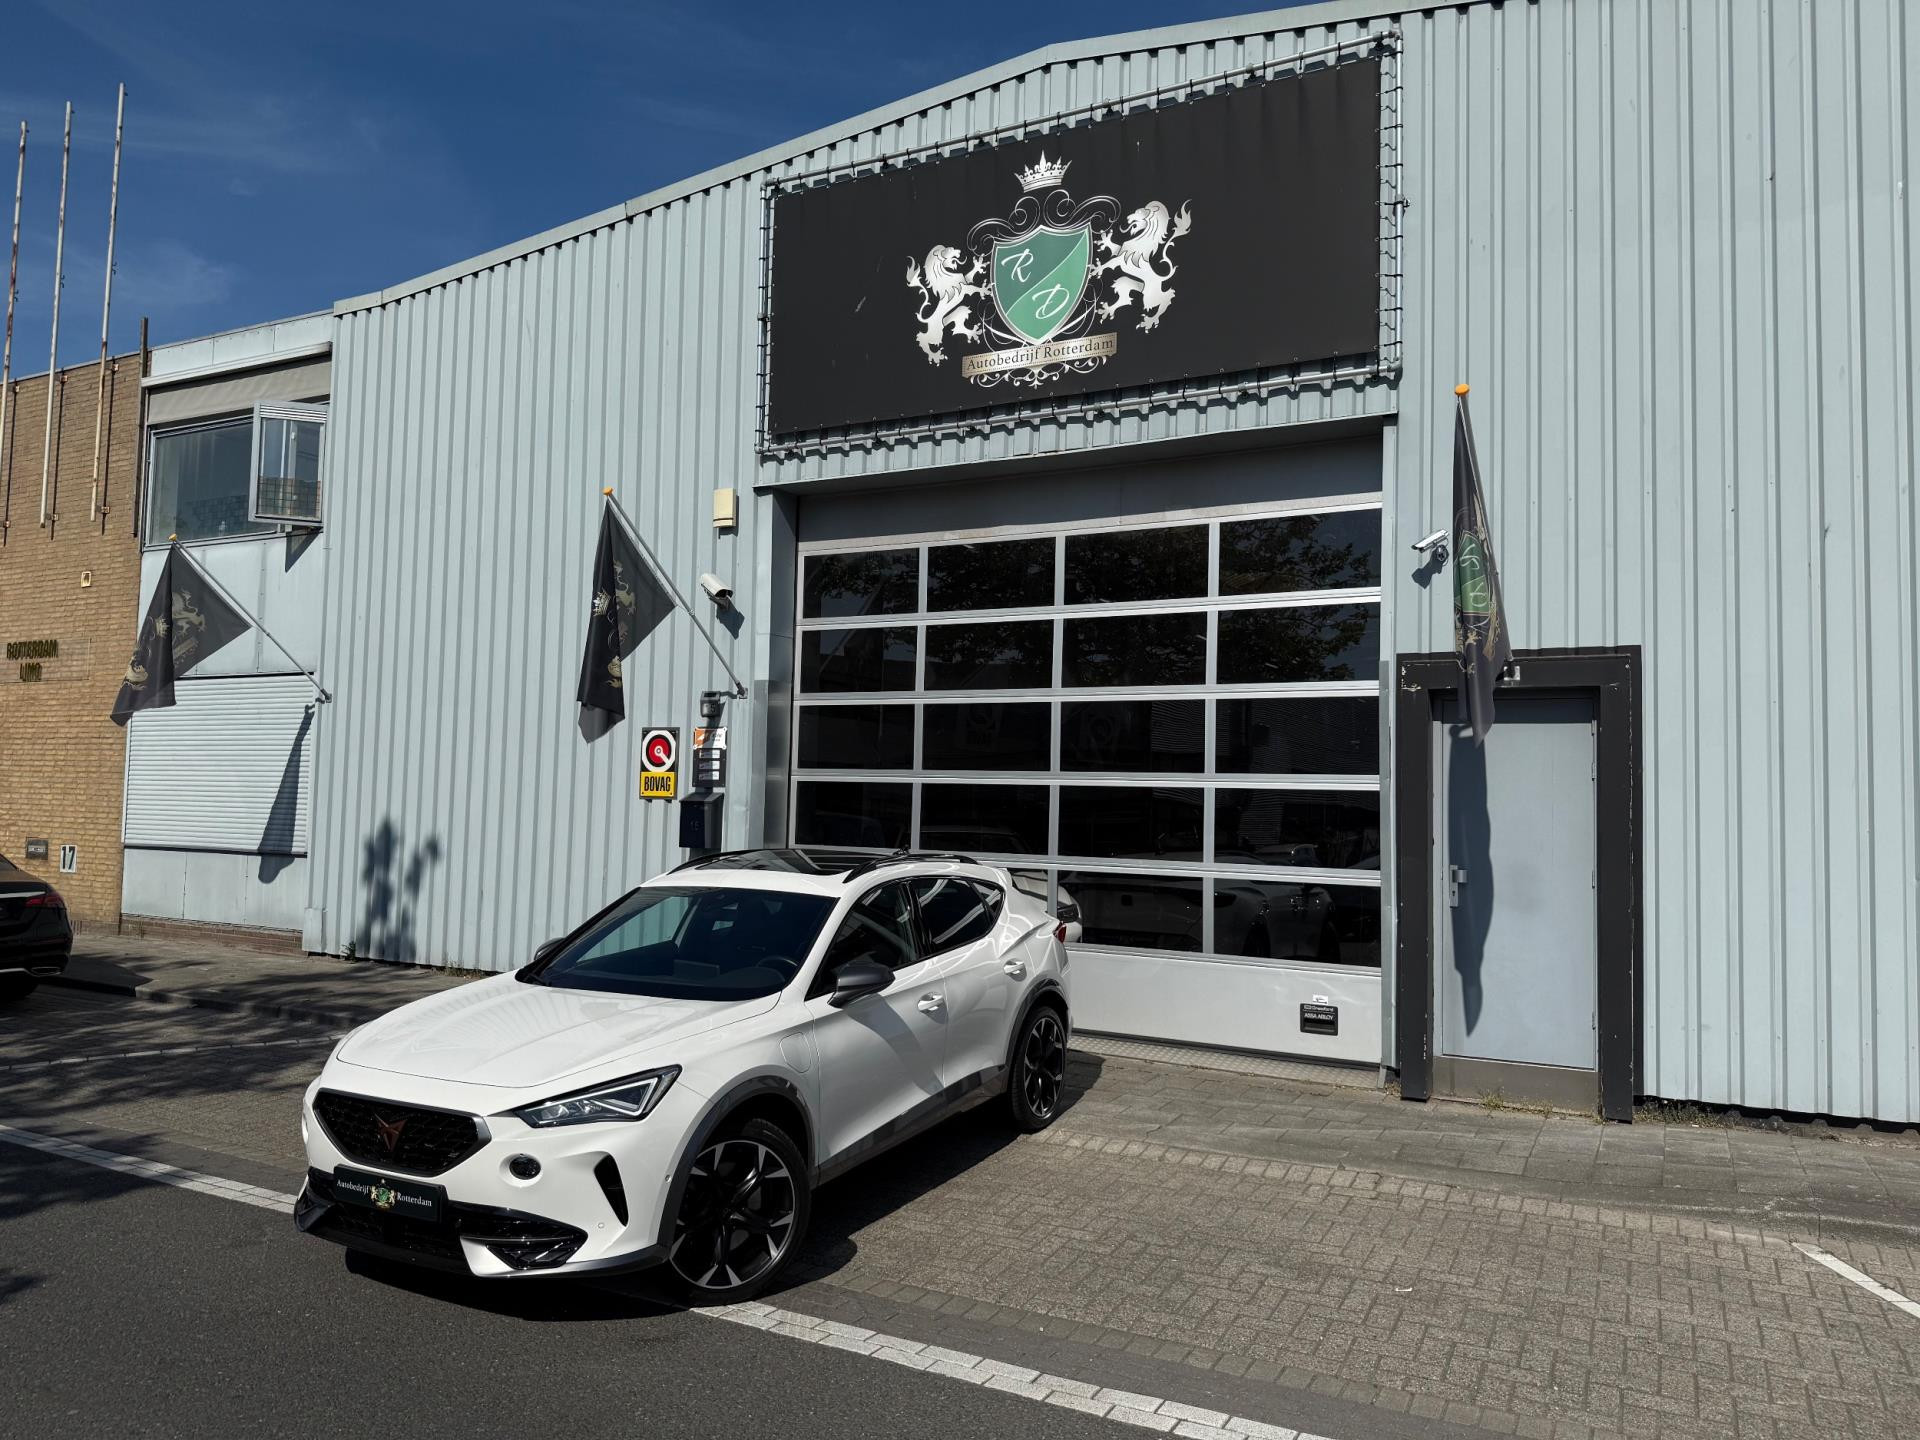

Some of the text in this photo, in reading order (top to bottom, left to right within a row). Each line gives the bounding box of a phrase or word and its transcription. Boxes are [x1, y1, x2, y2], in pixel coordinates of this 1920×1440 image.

[1001, 248, 1034, 282] R
[1032, 283, 1070, 319] D
[966, 339, 1114, 370] Autobedrijf Rotterdam
[6, 639, 58, 660] ROTTERDAM
[644, 776, 671, 792] BOVAG
[61, 846, 76, 870] 17
[337, 1179, 432, 1207] Autobedrijf Rotterdam
